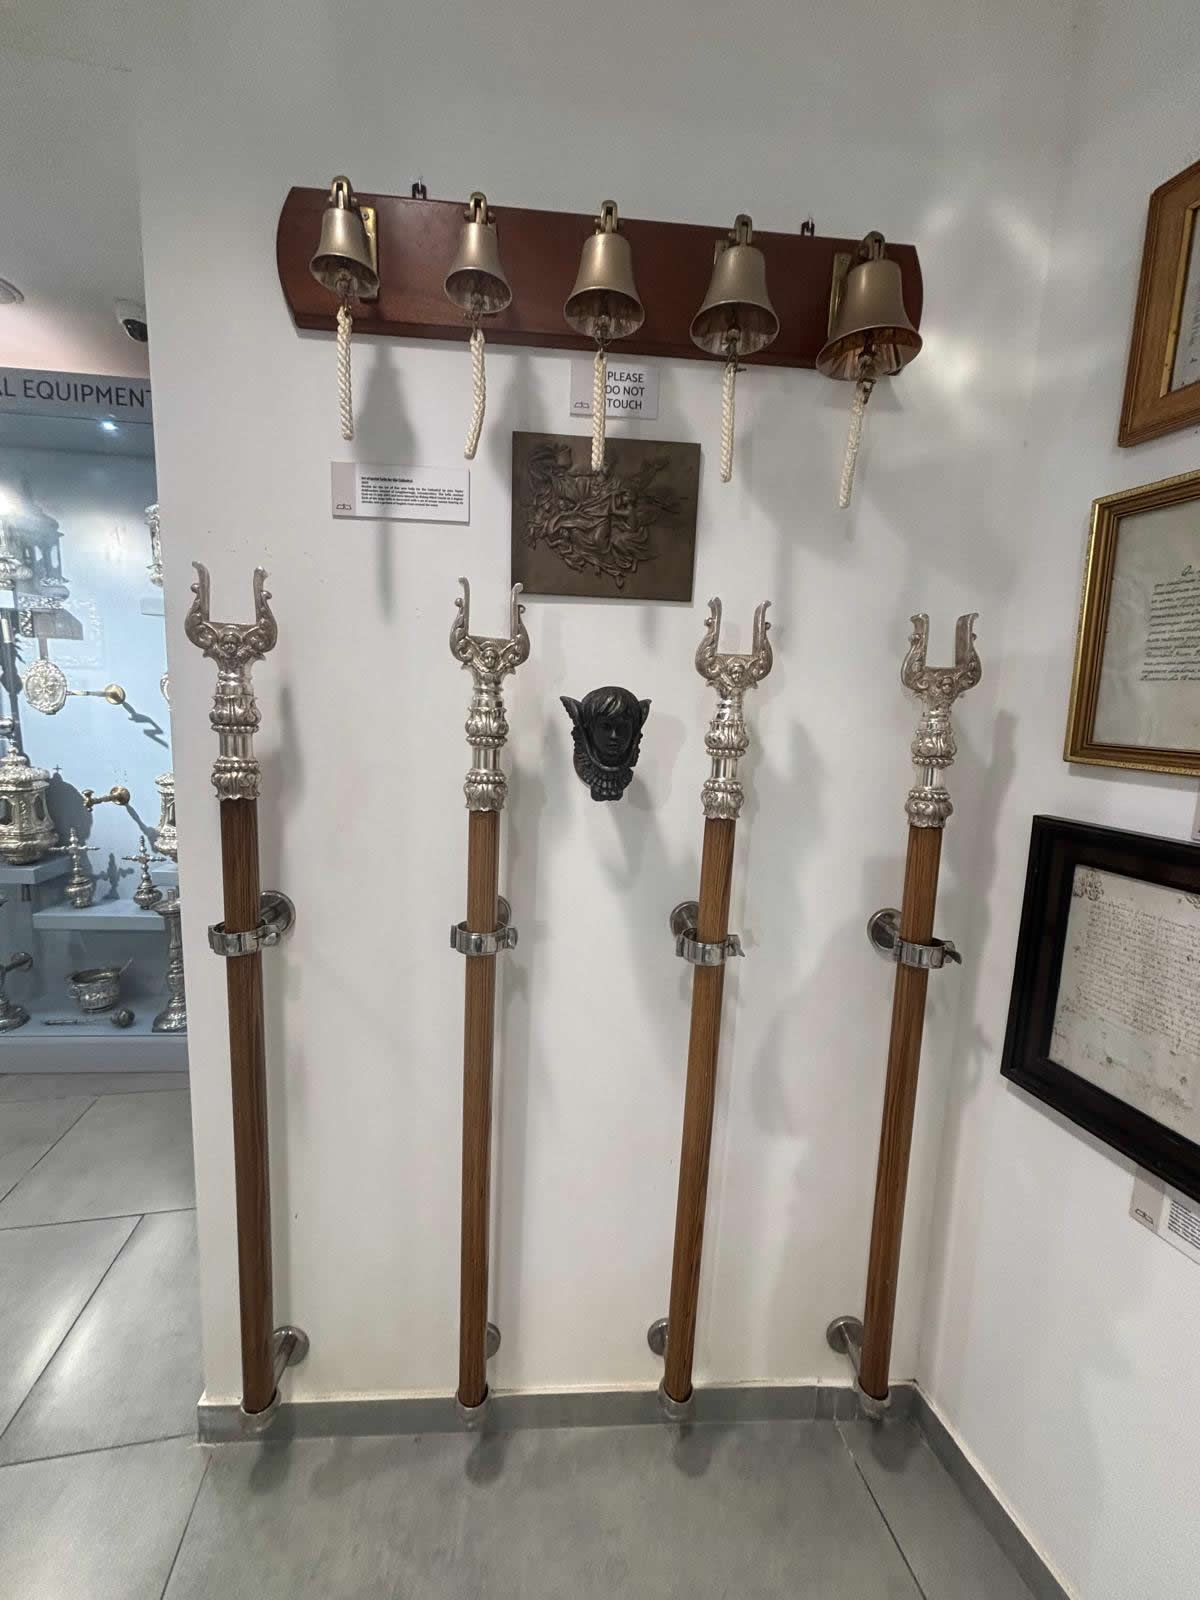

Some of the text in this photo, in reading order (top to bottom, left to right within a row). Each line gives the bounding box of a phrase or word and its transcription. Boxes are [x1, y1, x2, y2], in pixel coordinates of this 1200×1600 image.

[607, 371, 644, 383] PLEASE
[0, 377, 16, 397] L
[605, 385, 645, 397] DO NOT
[607, 398, 642, 410] TOUCH
